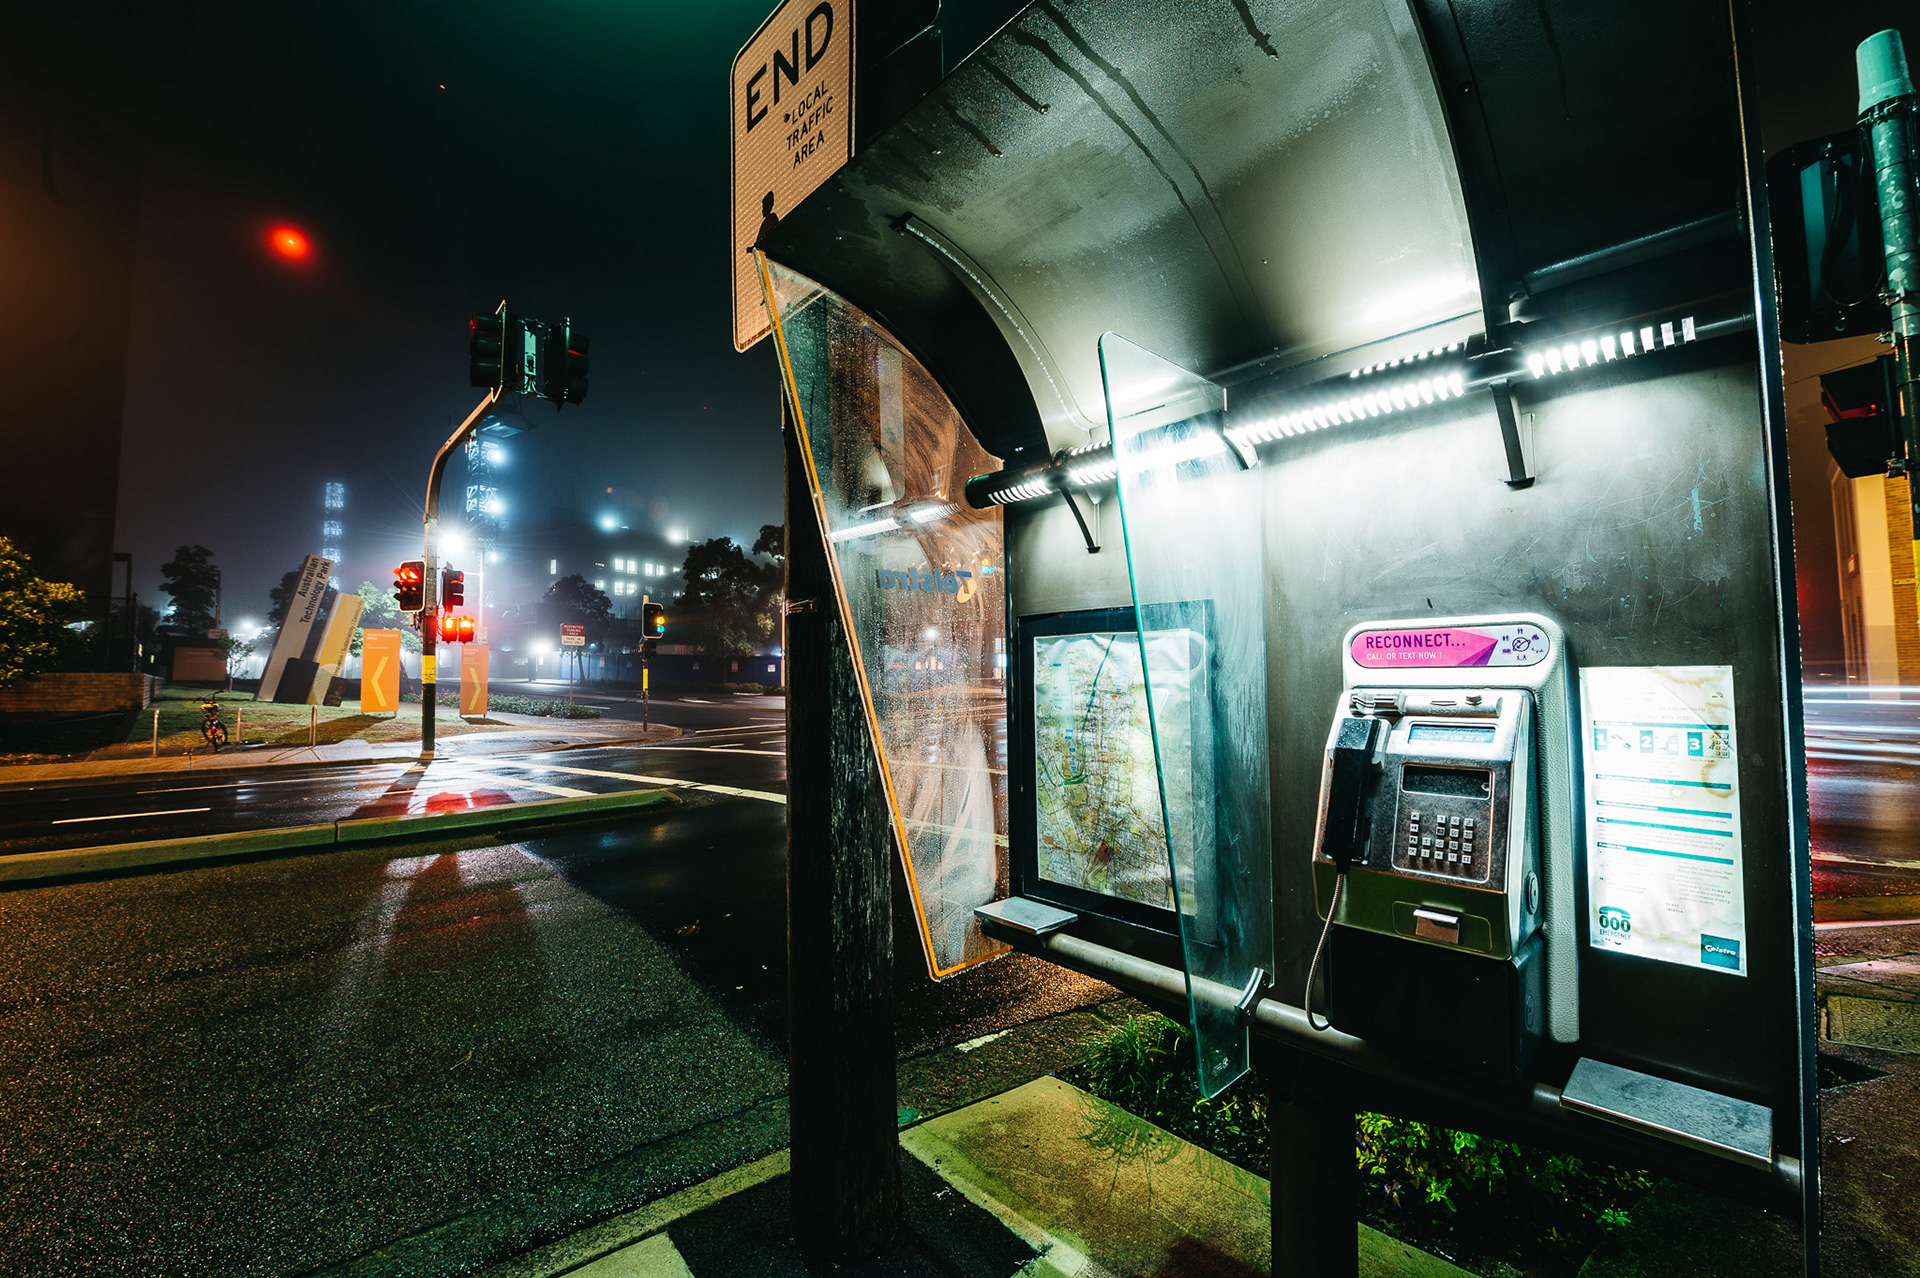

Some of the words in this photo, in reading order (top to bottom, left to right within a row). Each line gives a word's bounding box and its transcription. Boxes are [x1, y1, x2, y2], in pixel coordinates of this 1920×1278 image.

[746, 1, 834, 134] END
[792, 80, 829, 125] LOCAL
[786, 96, 834, 151] TRAFFIC
[793, 129, 825, 170] AREA
[298, 557, 319, 597] Australian
[300, 580, 325, 623] Technology
[316, 561, 331, 580] Park
[341, 625, 356, 652] Sustainability
[351, 600, 365, 623] Community
[1366, 633, 1466, 649] RECONNECT...
[1367, 652, 1385, 661] CALL
[1386, 652, 1397, 660] OR
[1399, 652, 1416, 660] TEXT
[1418, 651, 1436, 659] NOW
[1596, 733, 1606, 746] 1
[1640, 736, 1652, 748] 2
[1688, 738, 1700, 750] 3
[1599, 914, 1631, 933] 000
[1599, 928, 1632, 940] EMERGENCY
[1704, 944, 1736, 956] Telstra
